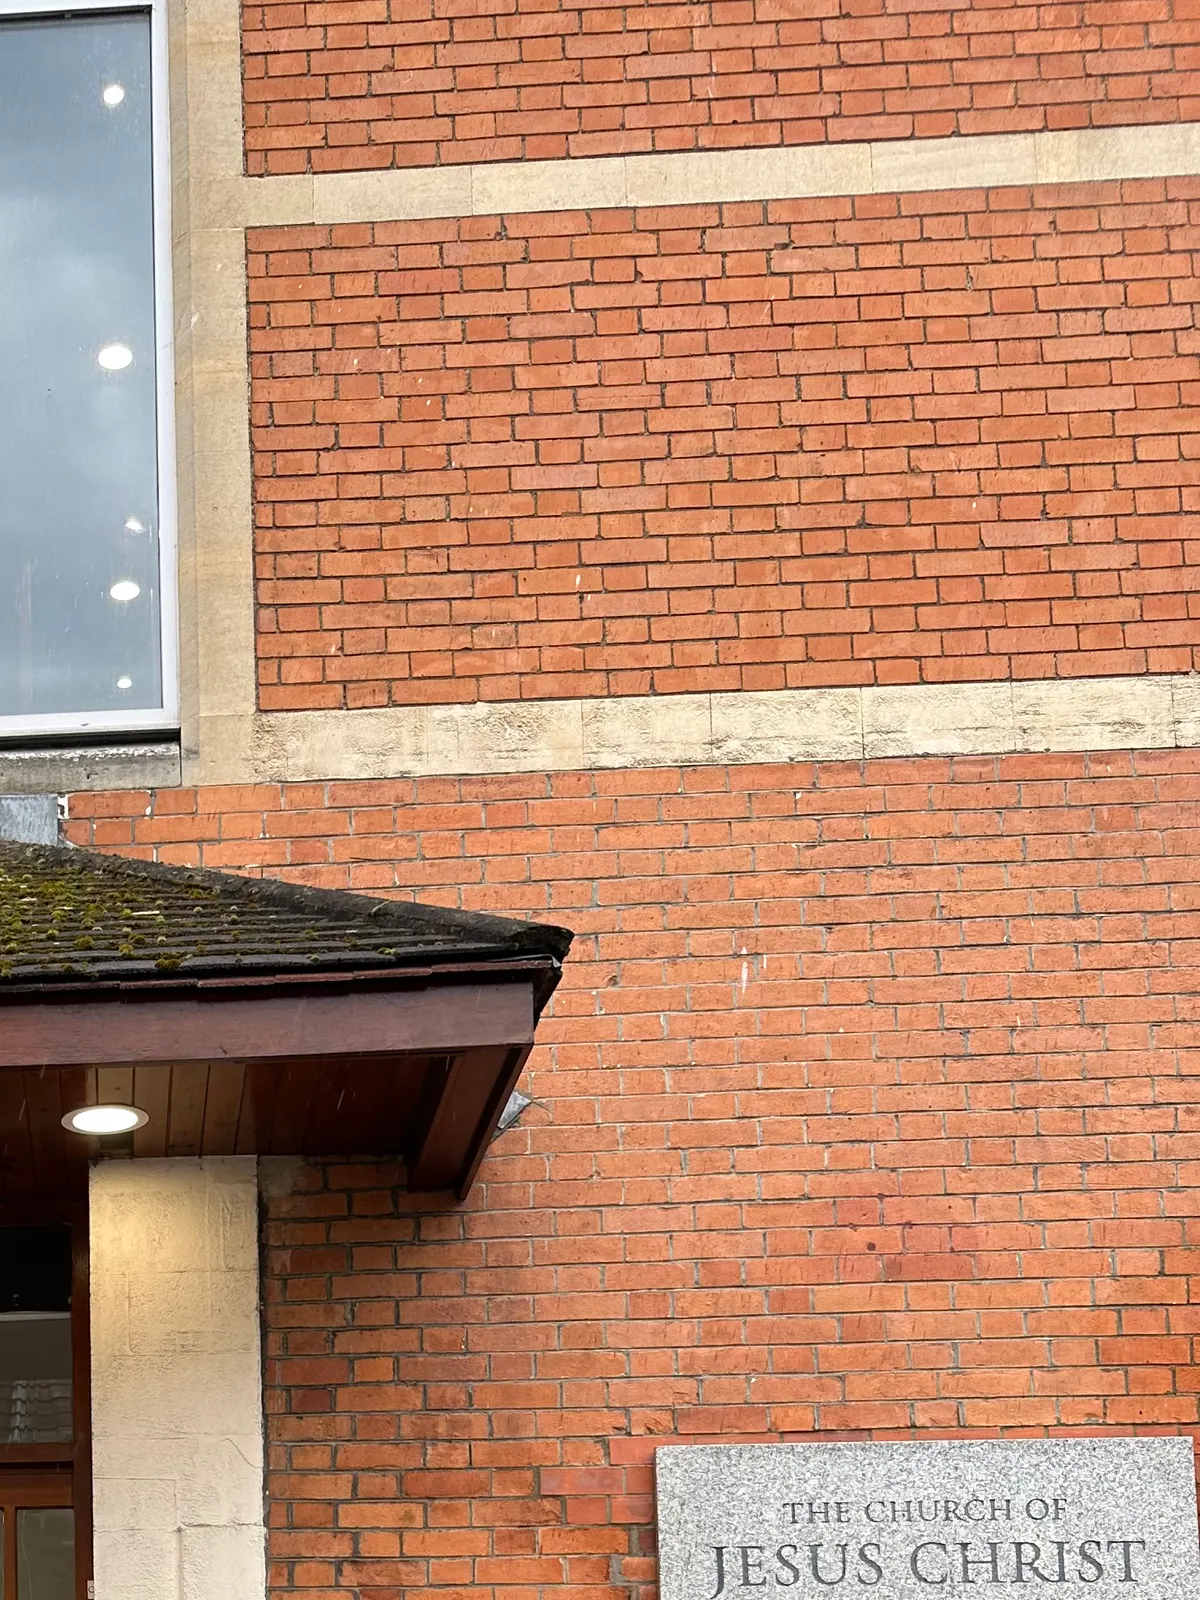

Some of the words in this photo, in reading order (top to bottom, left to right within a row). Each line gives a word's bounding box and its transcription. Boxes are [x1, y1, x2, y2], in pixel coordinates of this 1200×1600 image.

[783, 1500, 851, 1524] THE
[864, 1498, 1013, 1523] CHURCH
[1025, 1498, 1068, 1521] OF
[708, 1542, 884, 1600] JESUS
[910, 1539, 1146, 1585] CHRIST
